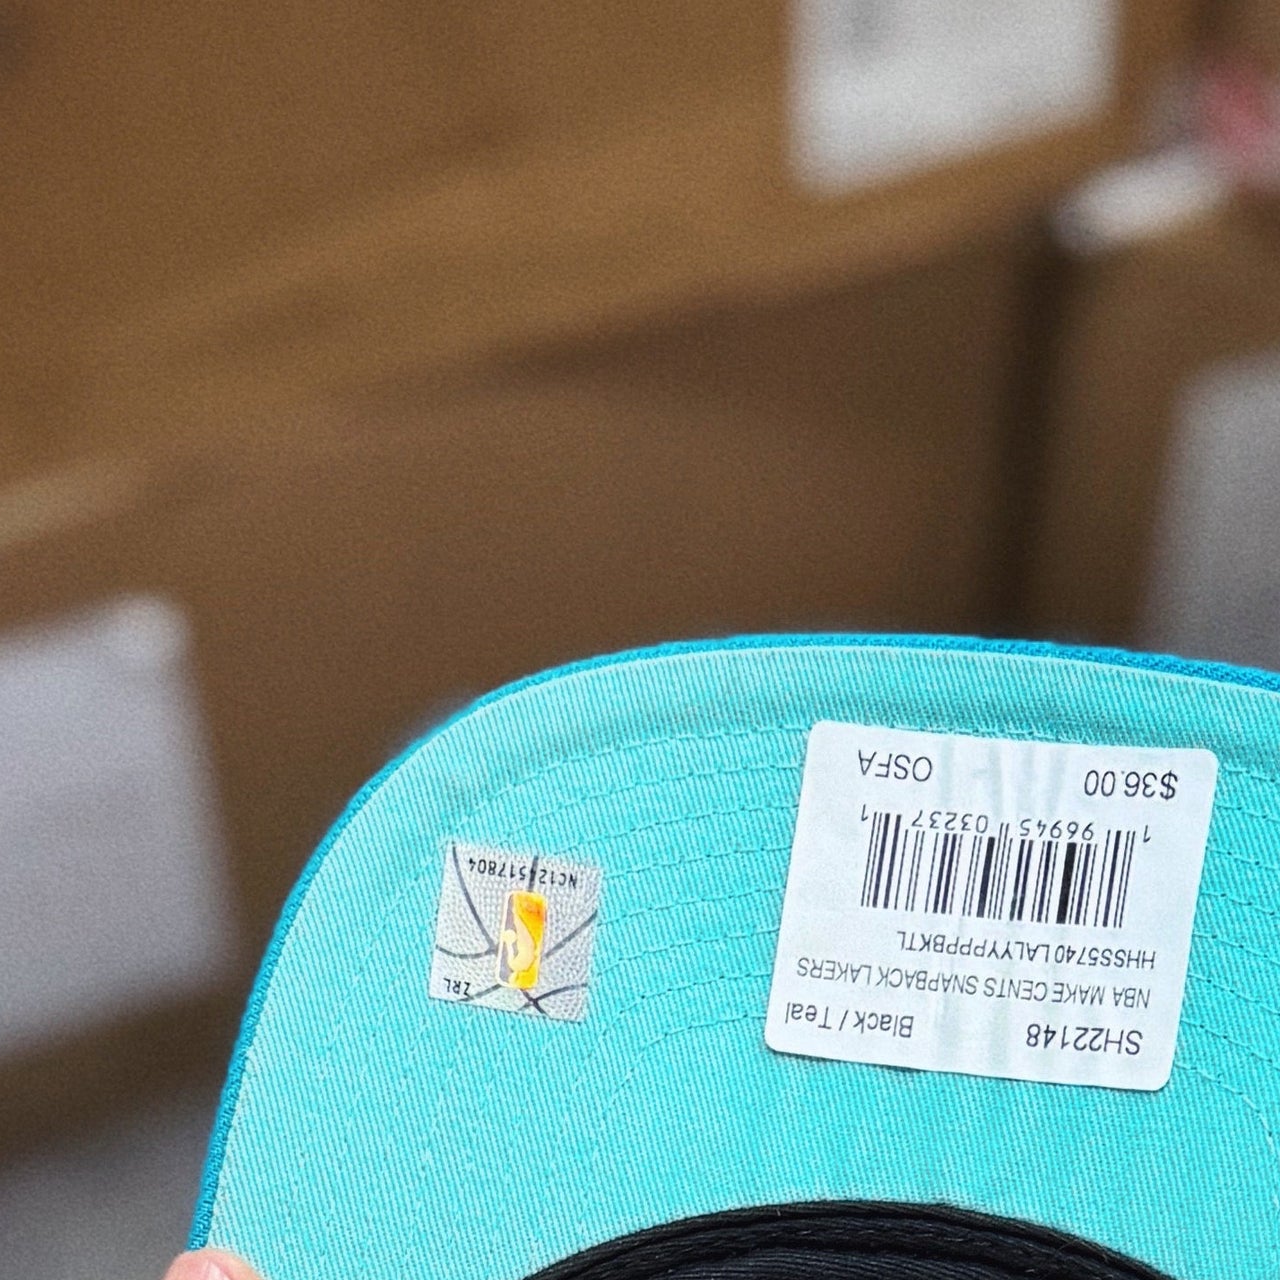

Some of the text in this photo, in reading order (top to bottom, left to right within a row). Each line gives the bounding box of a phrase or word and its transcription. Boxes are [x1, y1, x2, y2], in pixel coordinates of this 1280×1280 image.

[857, 749, 933, 783] OSFA
[1084, 769, 1179, 801] $36.00
[911, 809, 989, 834] 03237
[1019, 818, 1095, 841] 96945
[896, 930, 1156, 970] HHSS5740 LALYYPPPBKTL
[796, 957, 1151, 1009] NBA MAKE CENTS SNAPBACK LAKERS
[784, 1000, 832, 1031] Teal
[853, 1011, 914, 1039] Black
[1026, 1023, 1144, 1056] SH22148
